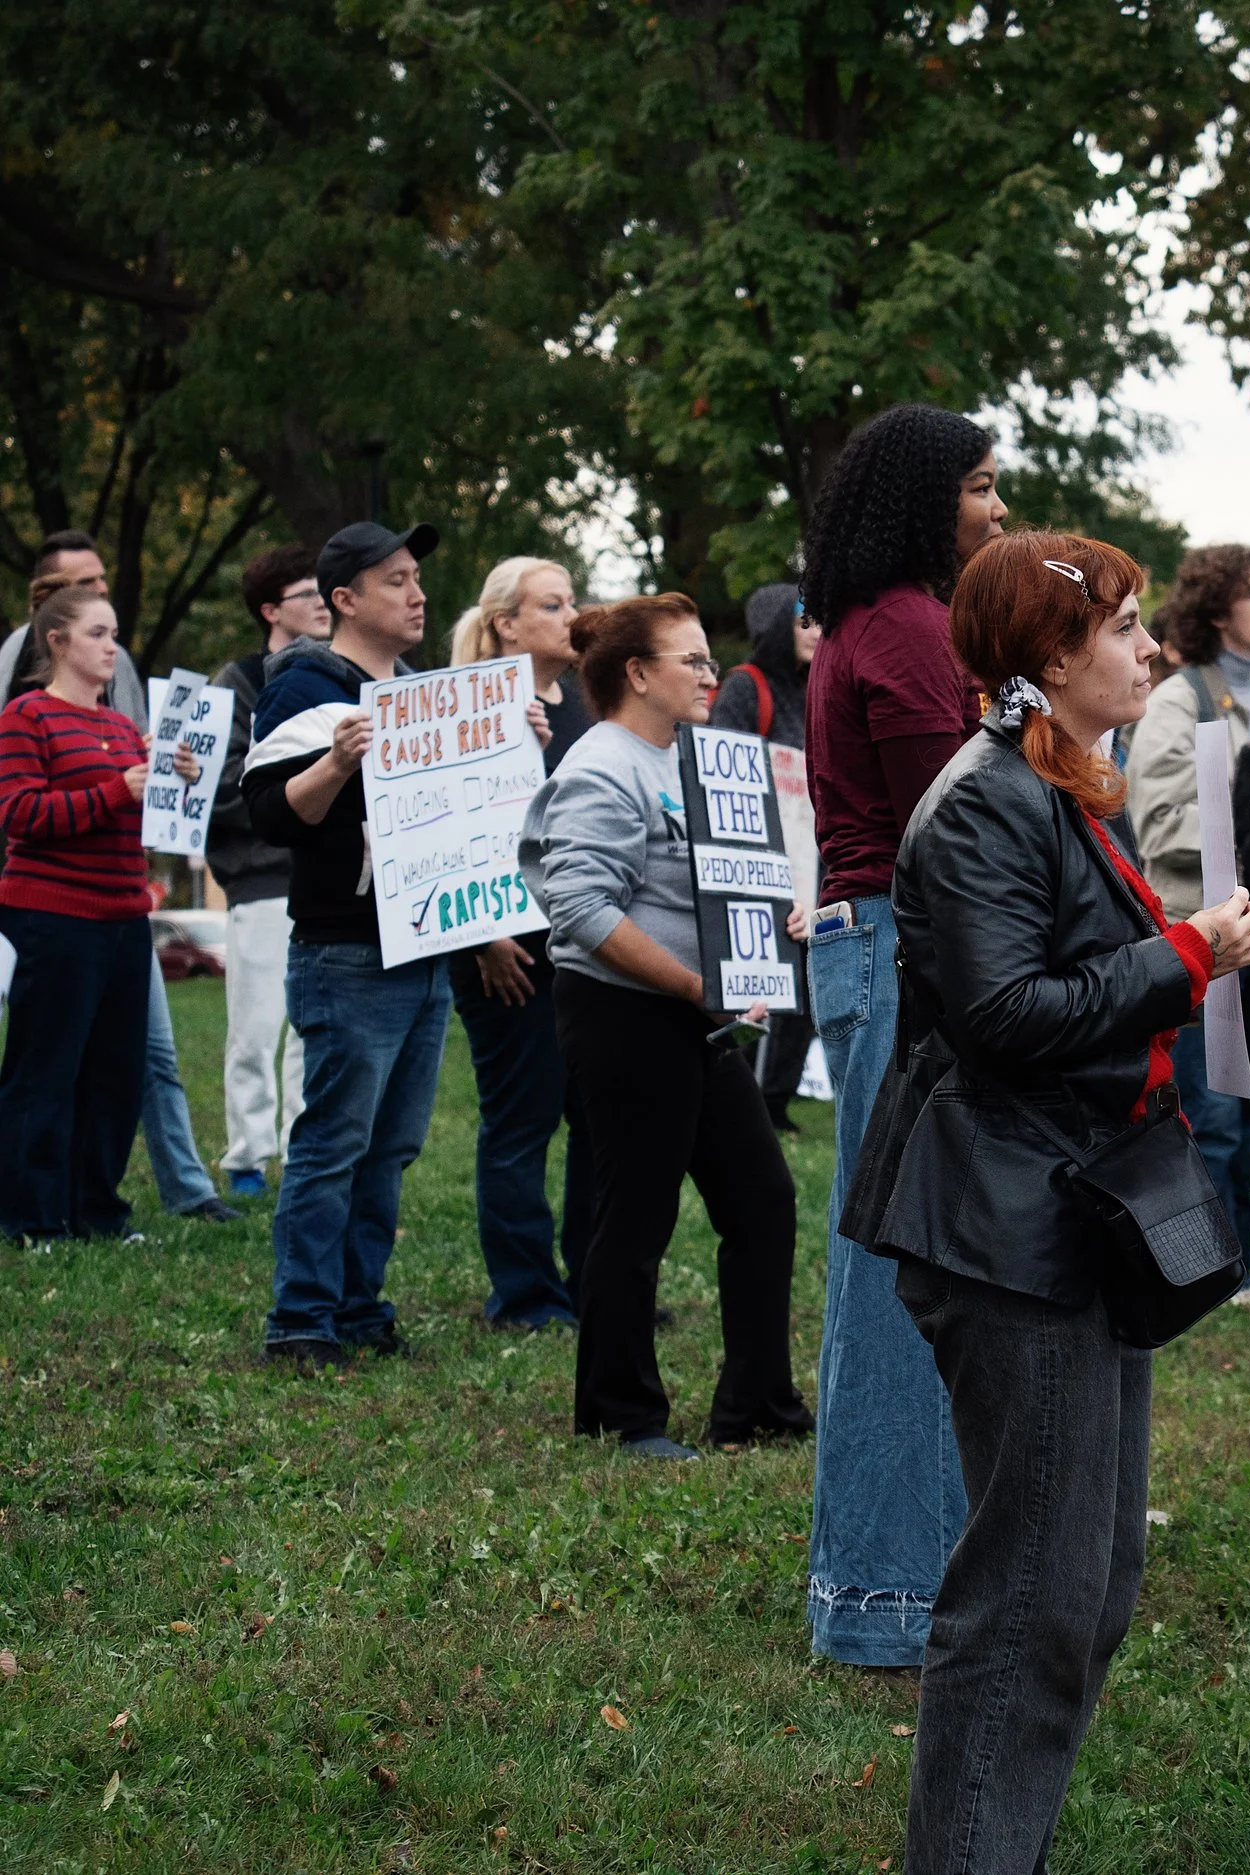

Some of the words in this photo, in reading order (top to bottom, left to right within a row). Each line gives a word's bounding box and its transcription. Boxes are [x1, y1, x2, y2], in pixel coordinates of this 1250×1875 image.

[191, 700, 211, 722] OP
[377, 676, 459, 730] THINGS
[468, 665, 518, 713] THAT
[184, 731, 217, 756] NDER
[380, 728, 443, 772] CAUSE
[457, 712, 506, 756] RAPE
[697, 736, 763, 784] LOCK
[396, 785, 449, 824] CLOTHING
[710, 788, 763, 835] THE
[437, 870, 528, 932] RAPISTS
[728, 907, 772, 960] UP
[726, 974, 790, 996] ALREADY!
